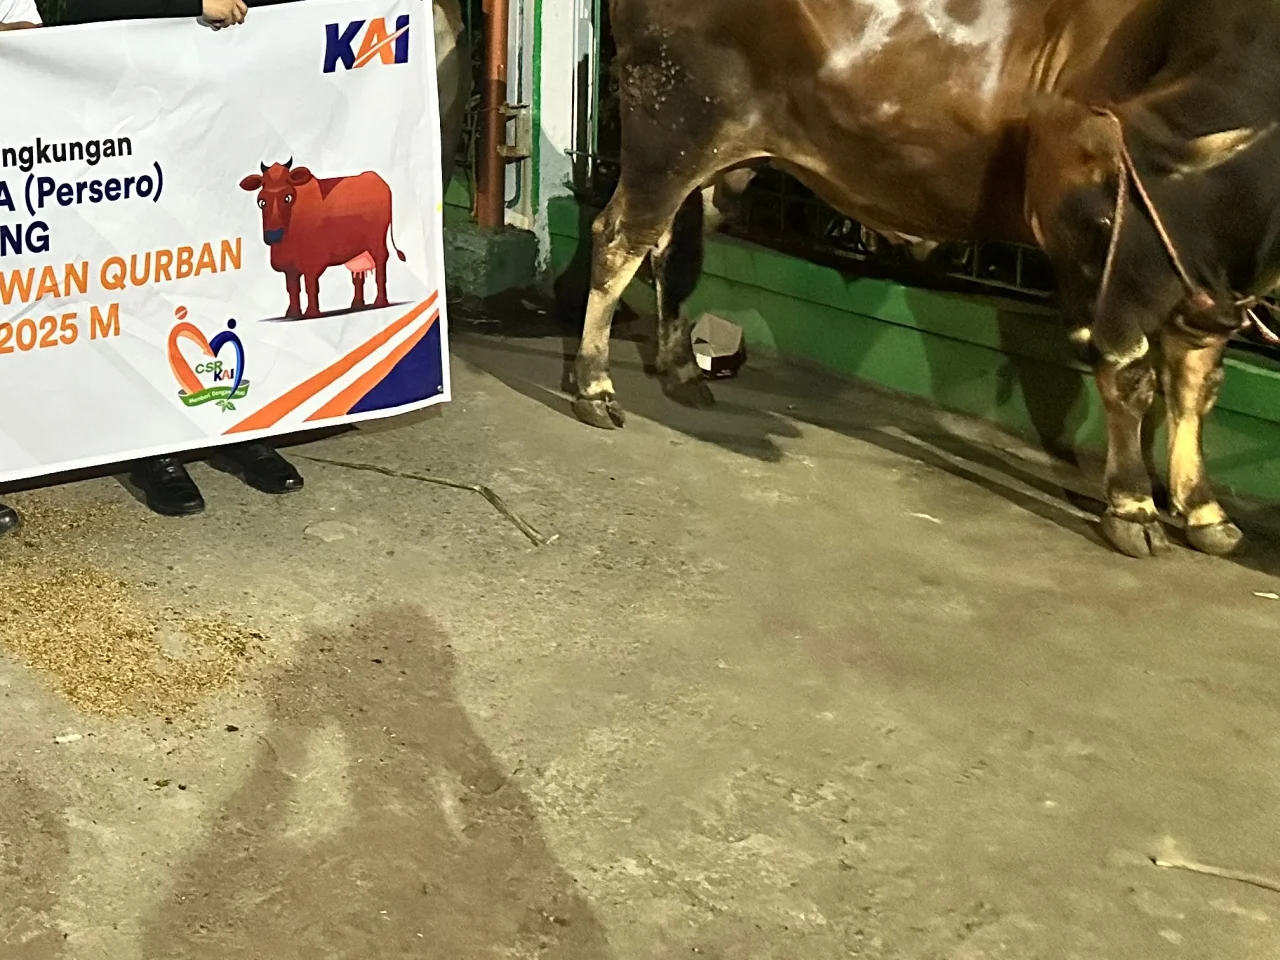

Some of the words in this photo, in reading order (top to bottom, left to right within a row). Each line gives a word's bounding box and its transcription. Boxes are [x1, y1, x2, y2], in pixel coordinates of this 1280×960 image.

[322, 14, 410, 74] KAI
[24, 162, 163, 217] (Persero)
[99, 236, 242, 291] QURBAN
[89, 303, 121, 341] M
[195, 360, 223, 375] CSR
[214, 368, 234, 381] KAI
